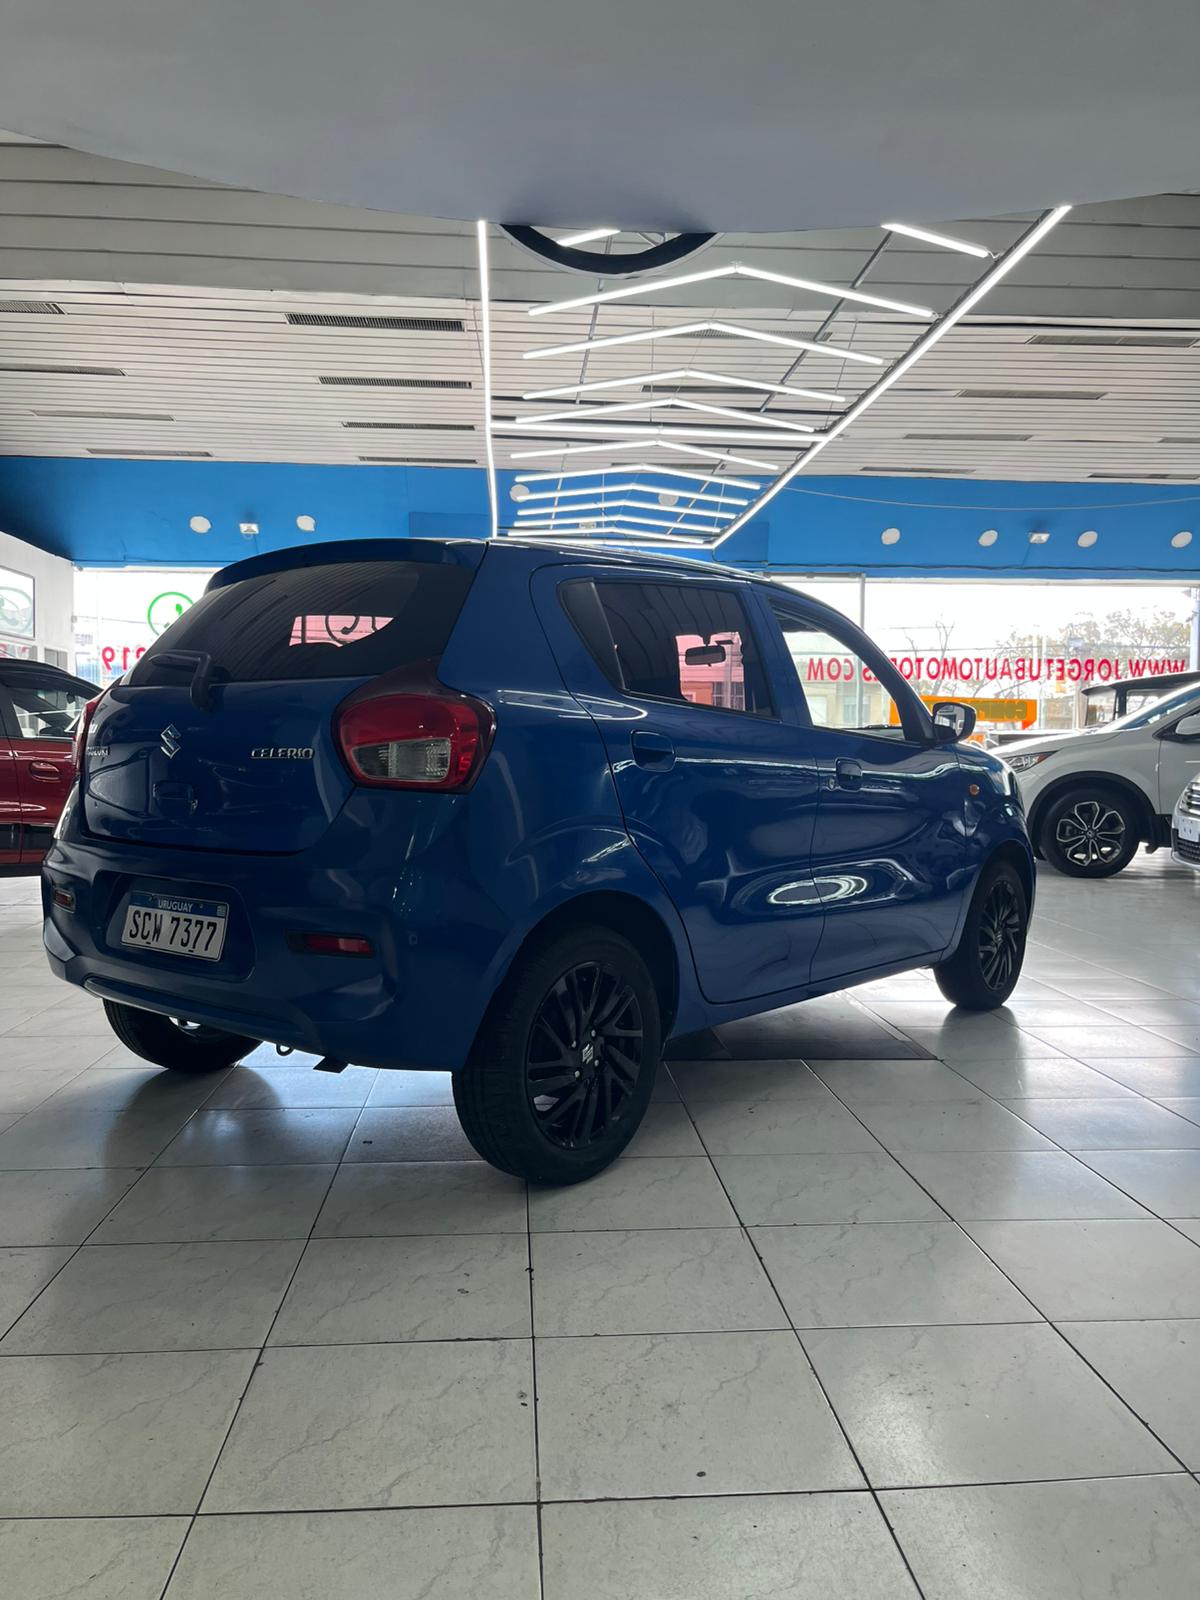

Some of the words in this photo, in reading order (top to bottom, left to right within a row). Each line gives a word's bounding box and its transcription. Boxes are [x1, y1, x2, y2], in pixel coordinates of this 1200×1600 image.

[250, 747, 314, 760] CELERIO
[157, 899, 194, 913] URUGUAY
[169, 916, 218, 951] 7377
